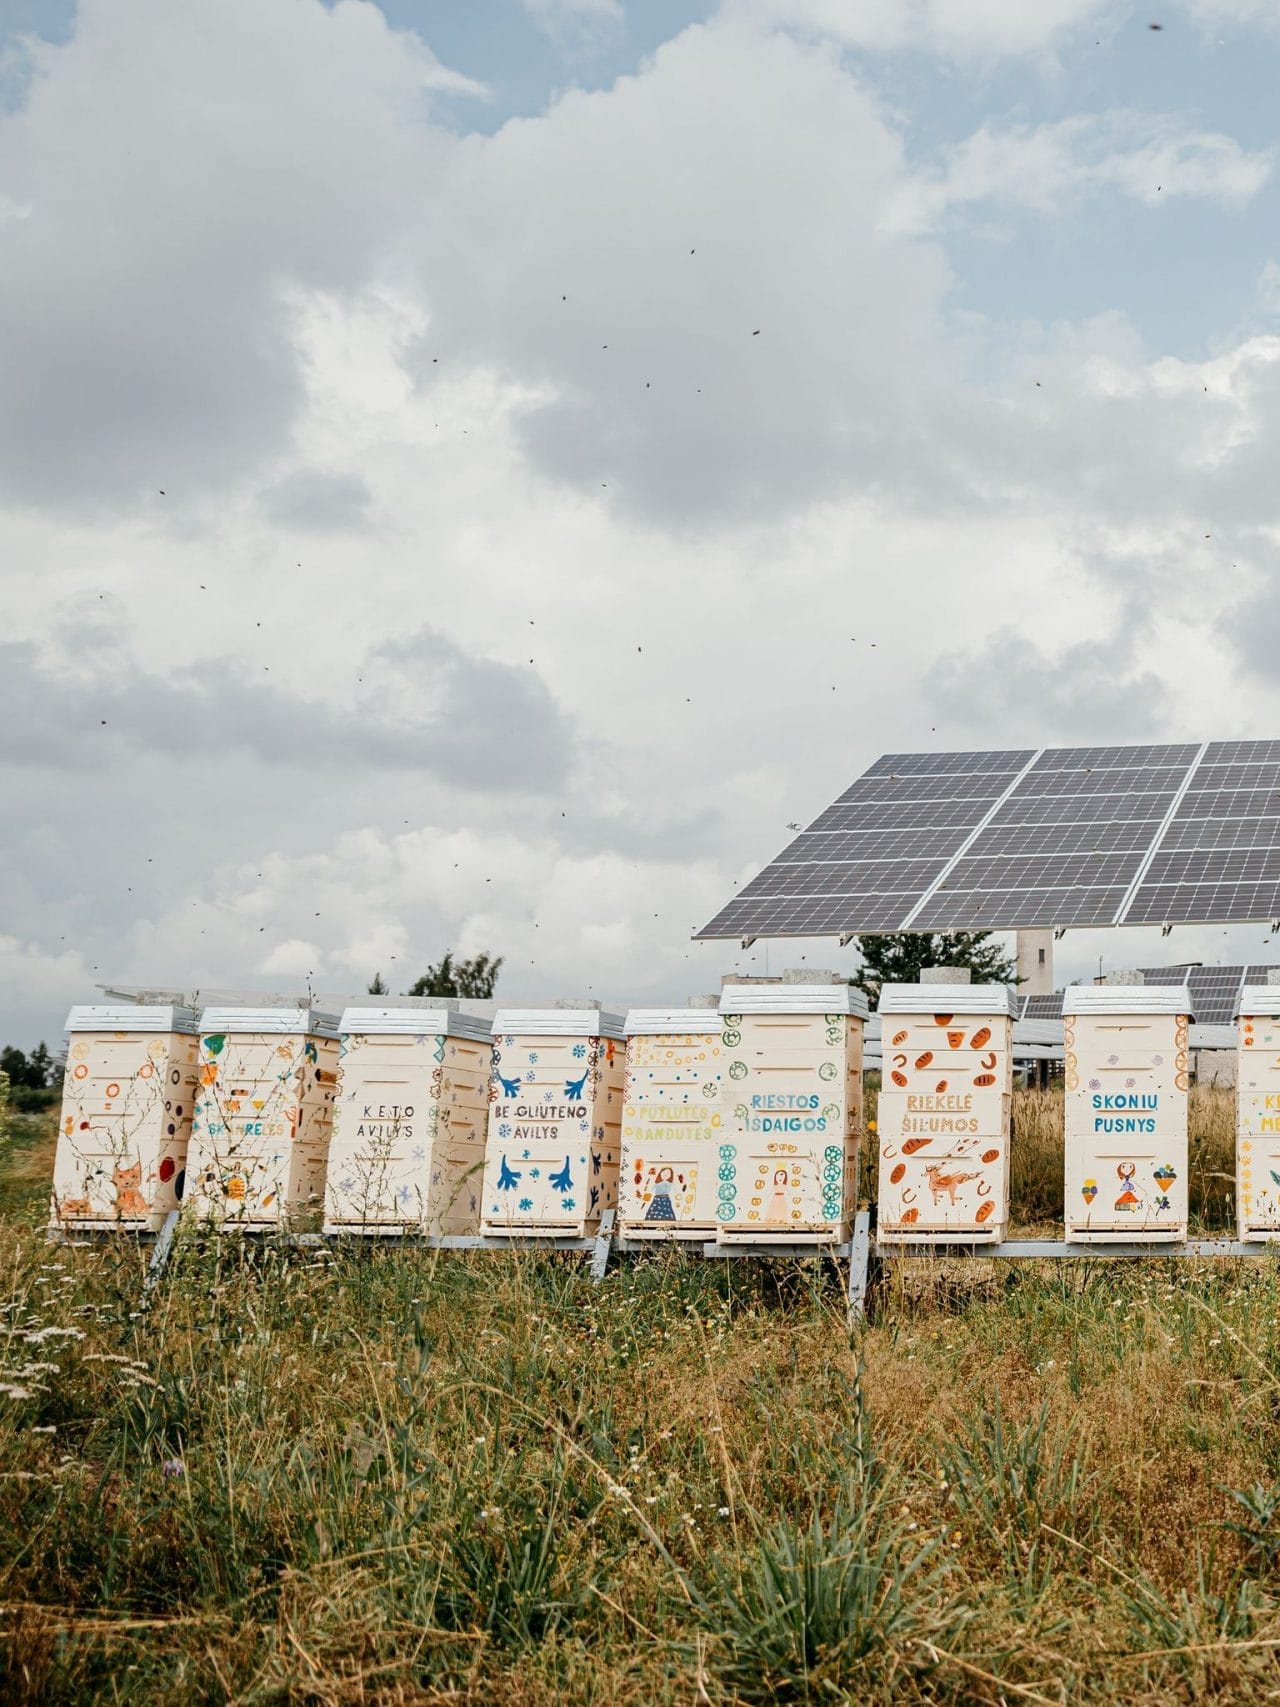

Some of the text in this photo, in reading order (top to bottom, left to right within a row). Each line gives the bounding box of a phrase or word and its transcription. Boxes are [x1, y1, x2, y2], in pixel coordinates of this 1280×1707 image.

[752, 1095, 819, 1108] RIESTOS
[363, 1105, 414, 1117] KETO
[495, 1106, 510, 1118] BE
[357, 1125, 412, 1137] AVILYS
[1095, 1118, 1155, 1132] PUSNYS
[514, 1126, 558, 1139] AVILYS
